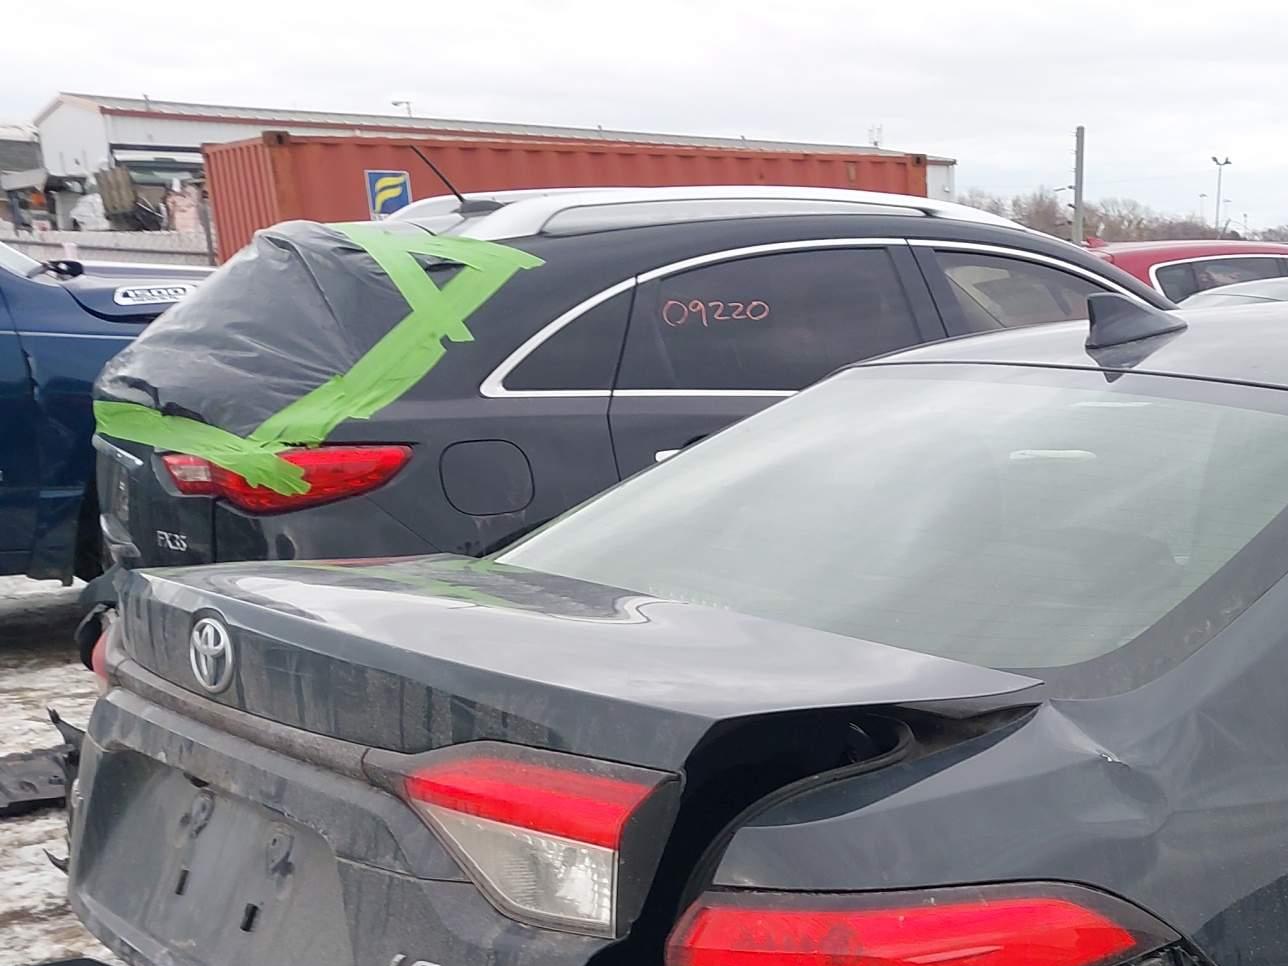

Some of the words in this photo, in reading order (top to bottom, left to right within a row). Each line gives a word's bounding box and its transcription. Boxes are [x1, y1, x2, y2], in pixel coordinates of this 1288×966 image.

[122, 286, 188, 299] 1500
[662, 299, 769, 327] 09220
[156, 530, 188, 551] FX35
